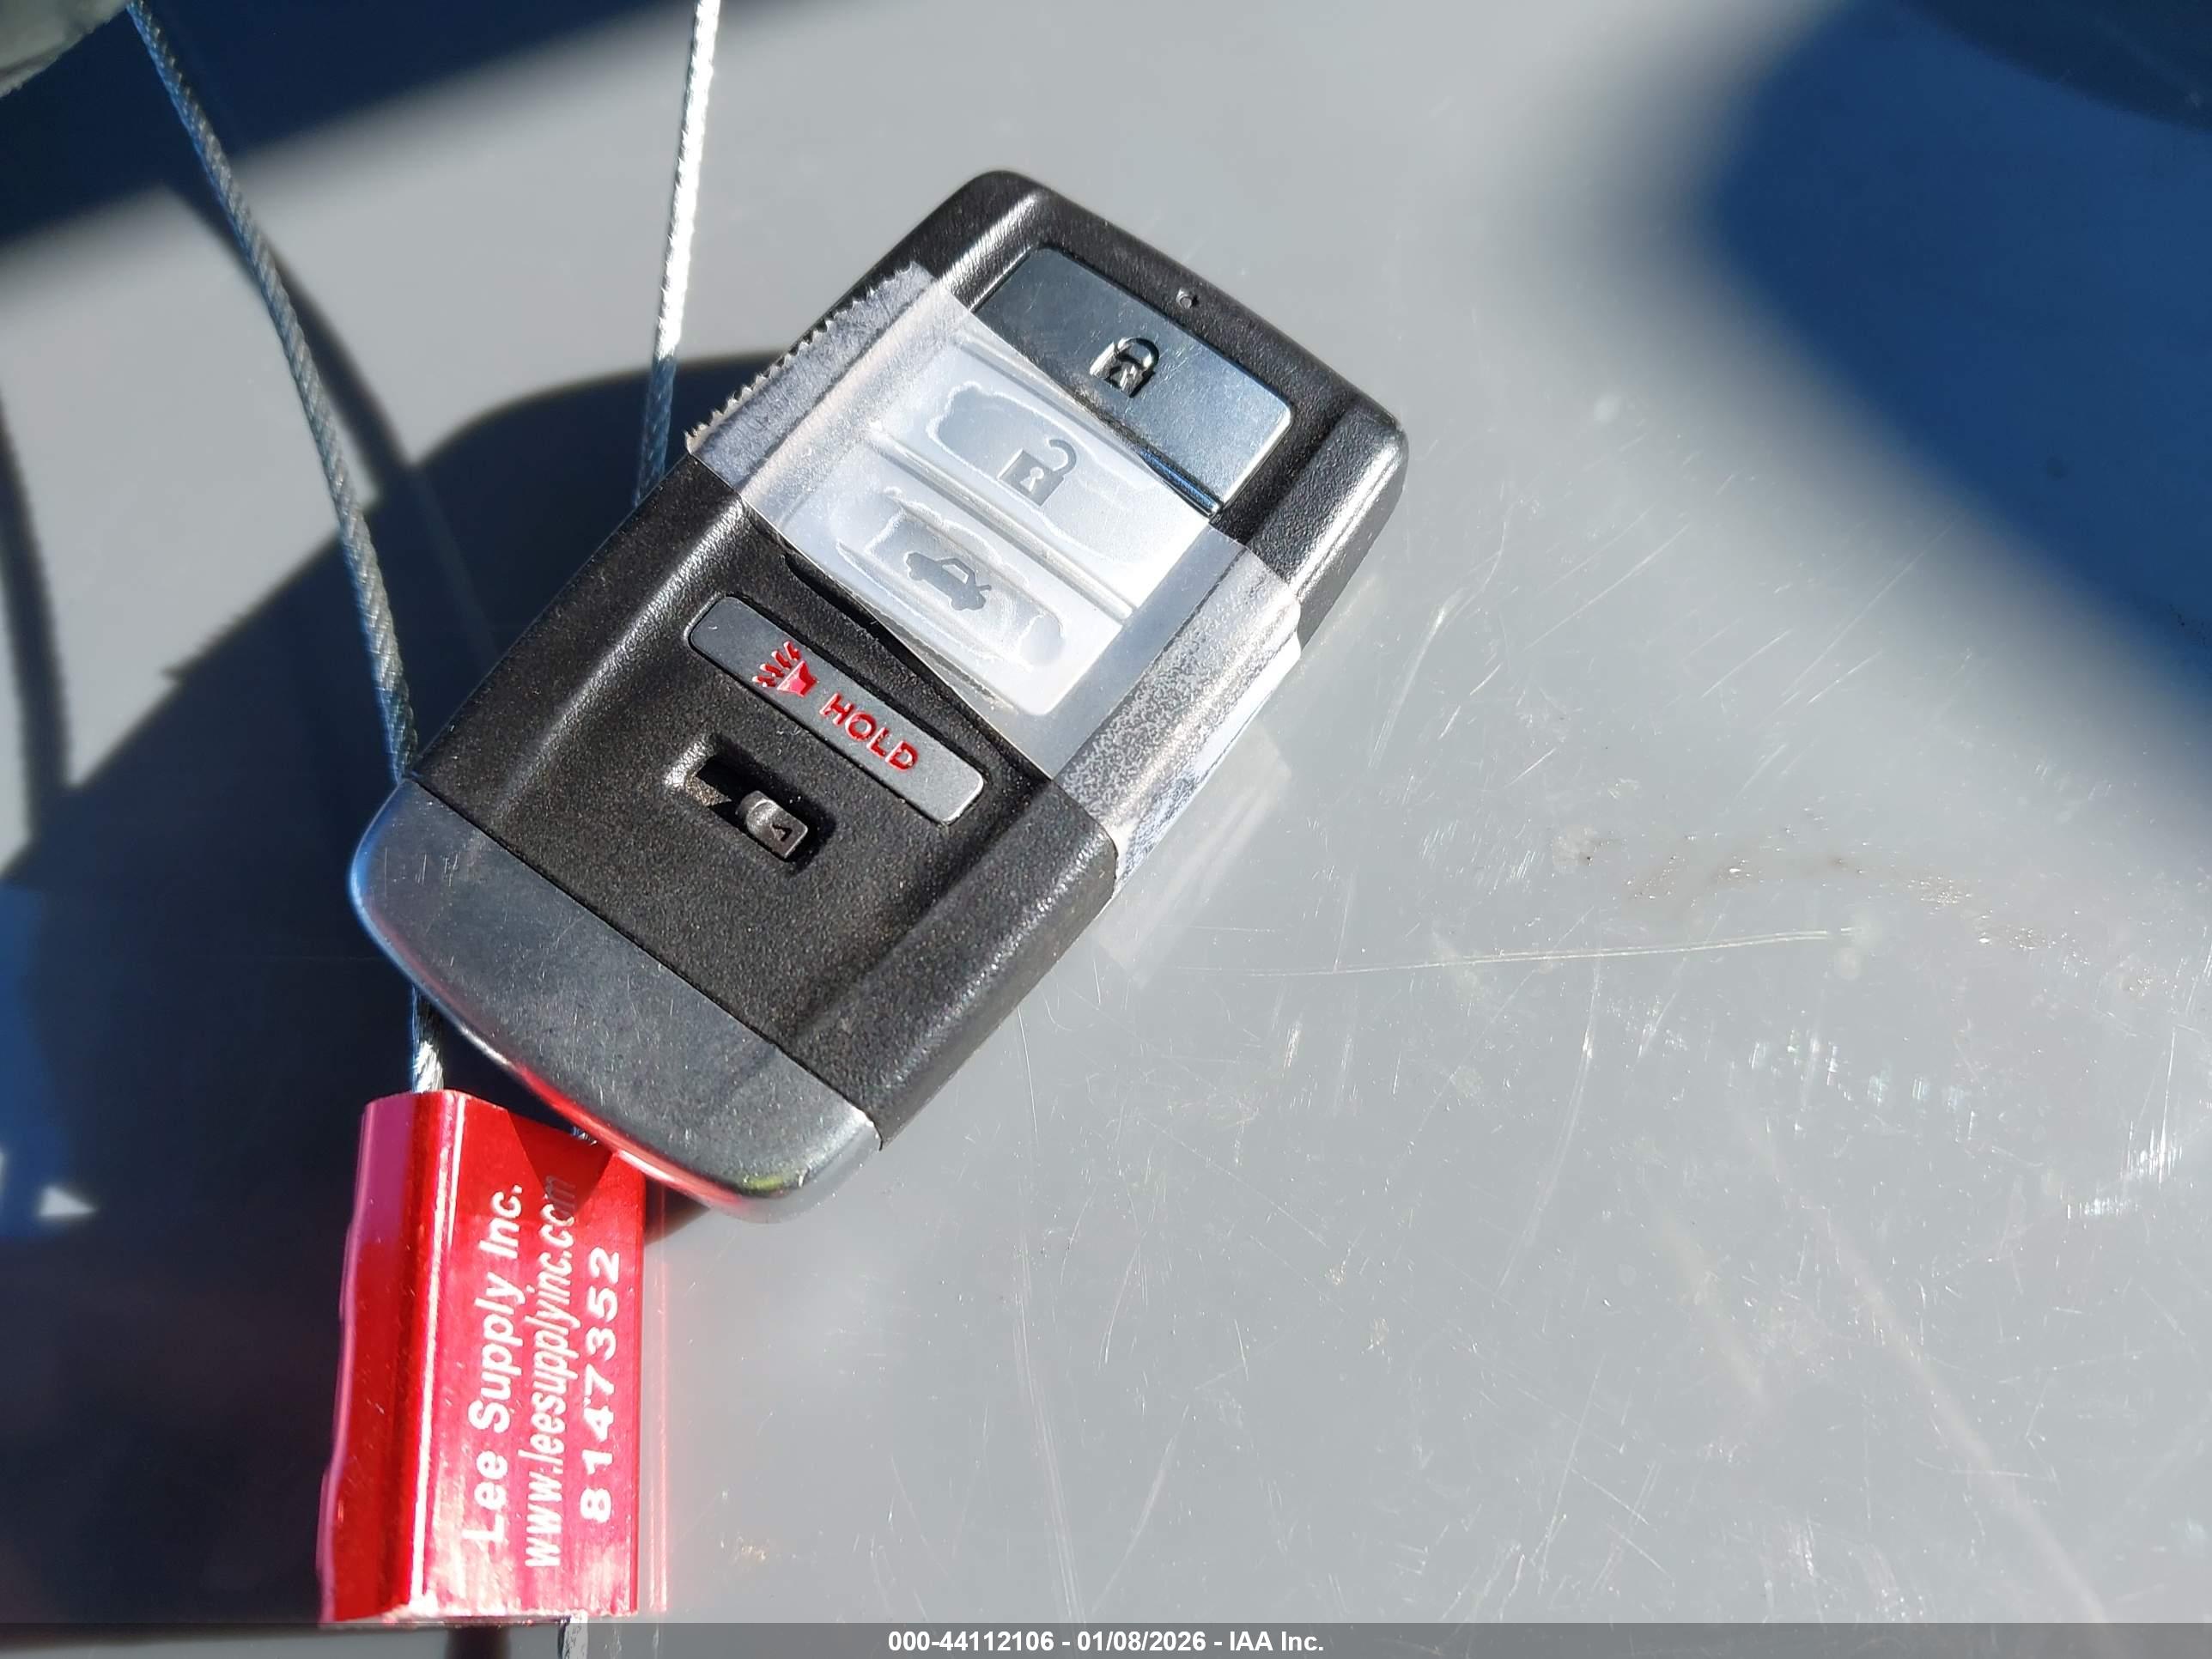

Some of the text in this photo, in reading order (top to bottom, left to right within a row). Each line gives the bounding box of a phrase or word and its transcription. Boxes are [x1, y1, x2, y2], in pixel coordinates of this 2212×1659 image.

[819, 693, 919, 770] HOLD
[464, 1183, 526, 1545] Lee Supply Inc.
[518, 1174, 582, 1570] www.leesupplyinc.com
[579, 1246, 621, 1524] 8147352
